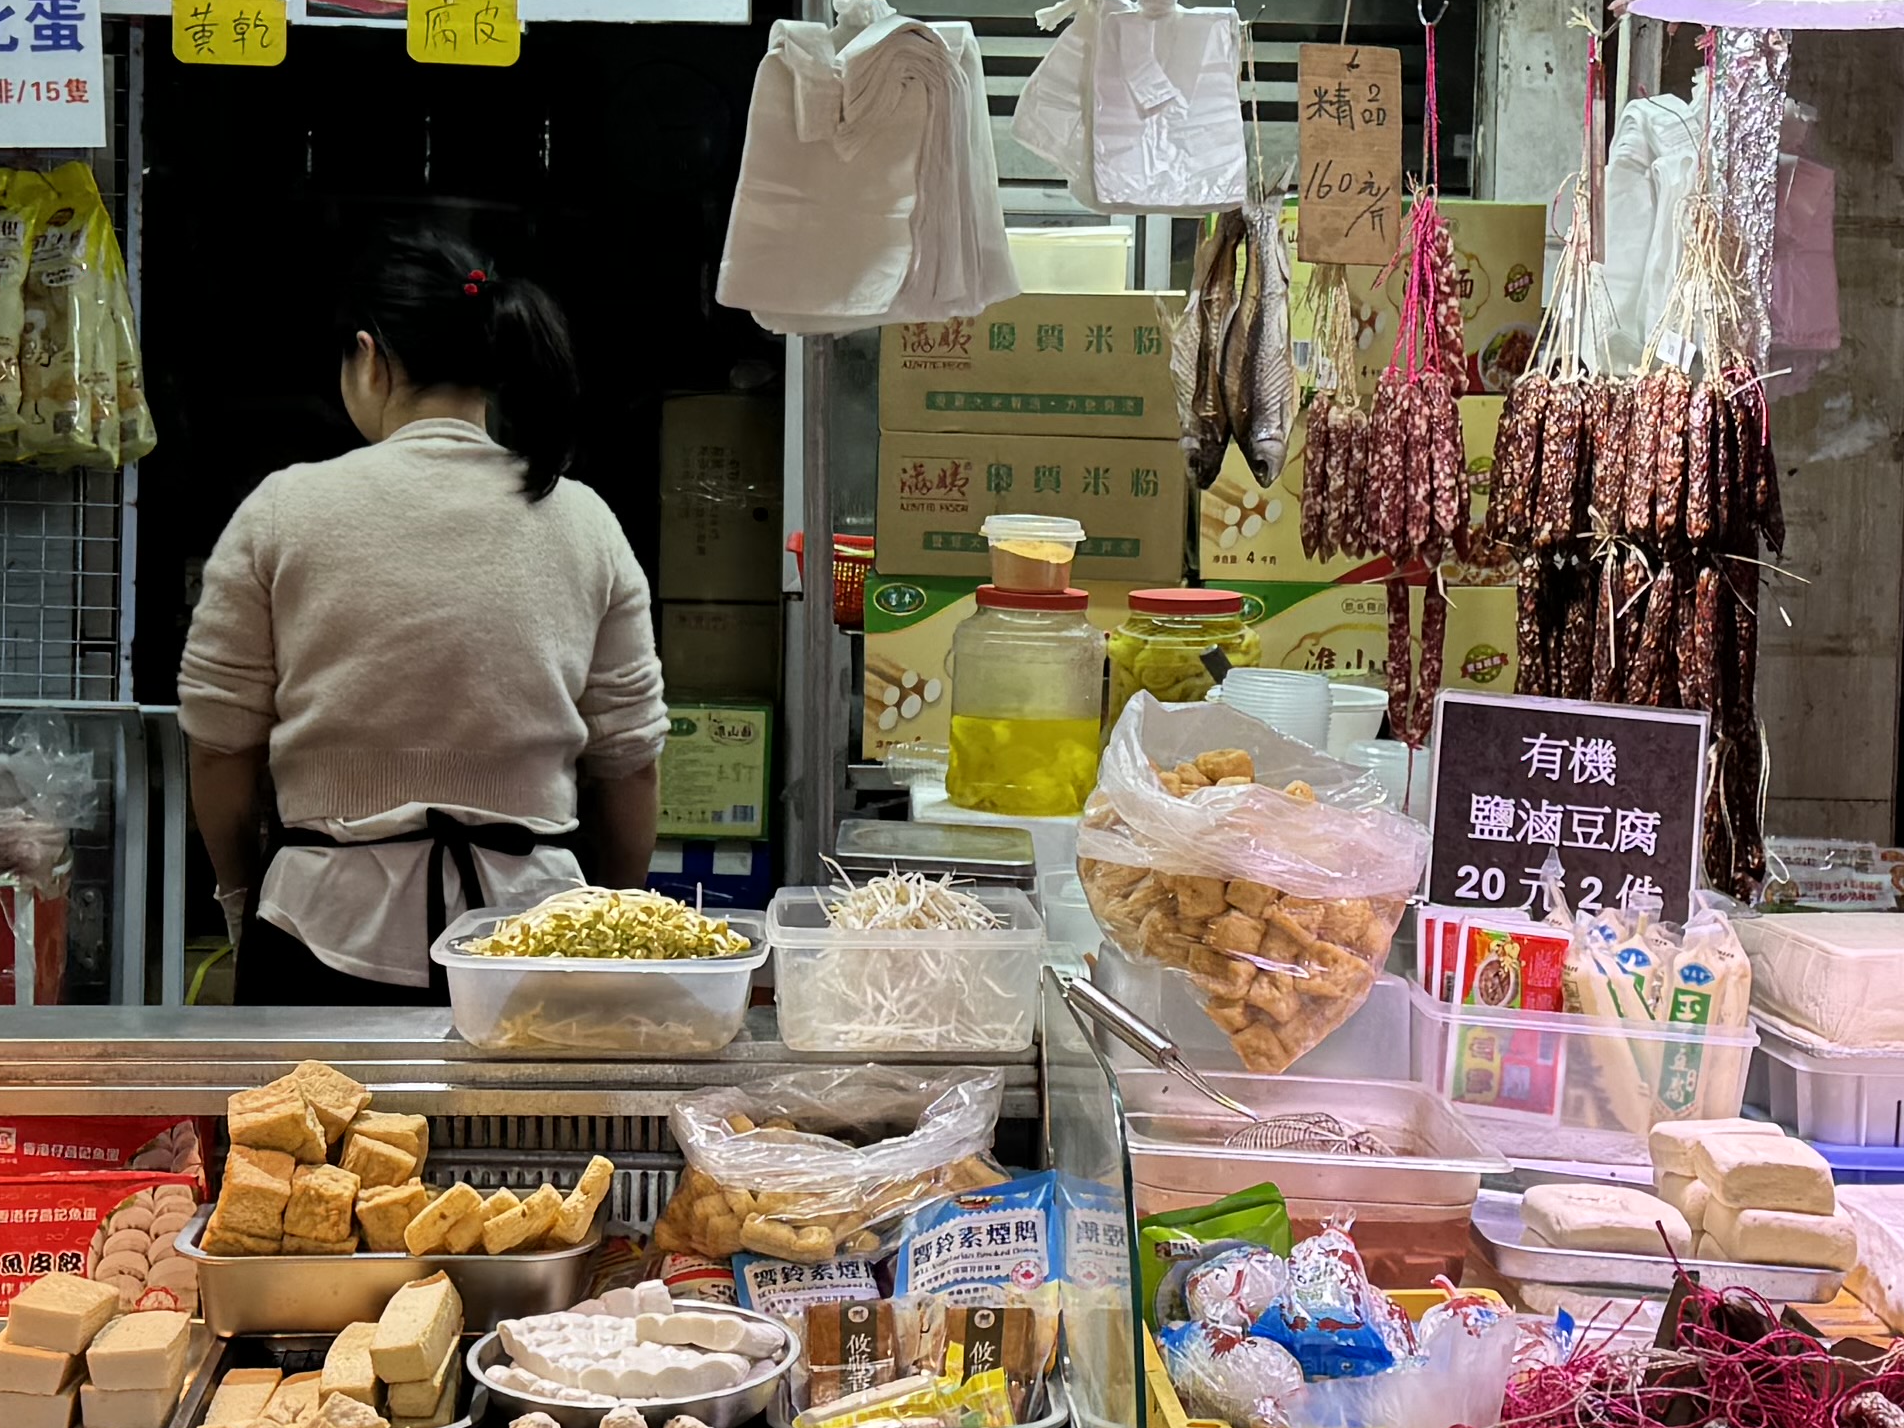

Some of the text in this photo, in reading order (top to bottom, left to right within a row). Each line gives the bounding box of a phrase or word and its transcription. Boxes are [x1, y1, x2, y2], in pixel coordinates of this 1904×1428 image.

[1306, 81, 1387, 132] 精品
[989, 322, 1164, 356] 優質米粉
[986, 462, 1160, 498] 優質米粉
[1519, 731, 1617, 787] 有機
[1454, 864, 1506, 902] 20
[1577, 876, 1603, 910] 2
